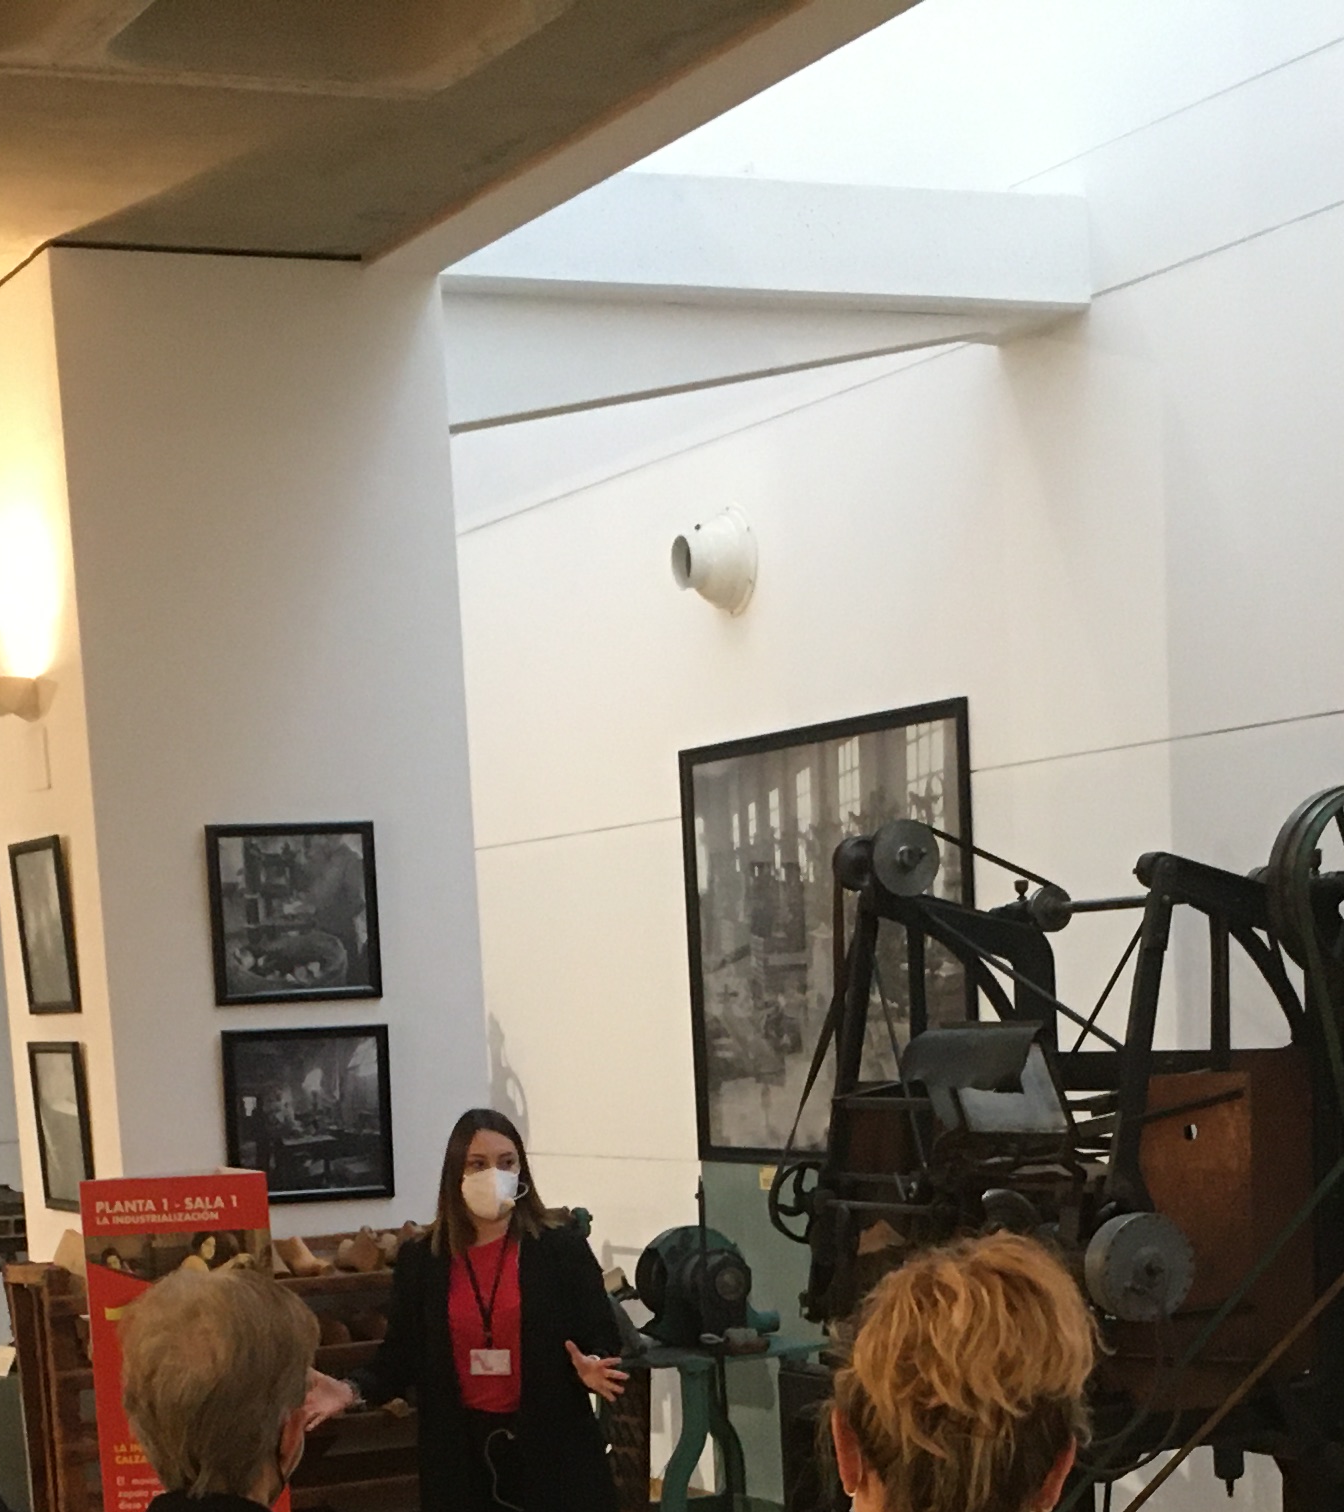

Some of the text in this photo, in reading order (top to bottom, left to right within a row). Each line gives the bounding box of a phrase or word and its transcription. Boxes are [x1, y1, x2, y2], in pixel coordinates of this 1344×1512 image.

[95, 1199, 156, 1214] PLANTA
[161, 1198, 169, 1211] 1
[184, 1195, 225, 1210] SALA
[230, 1194, 238, 1208] 1
[95, 1209, 219, 1225] LA INDUSTRIALIZACIÓN
[114, 1442, 144, 1453] LA IN
[115, 1454, 148, 1465] CALZA
